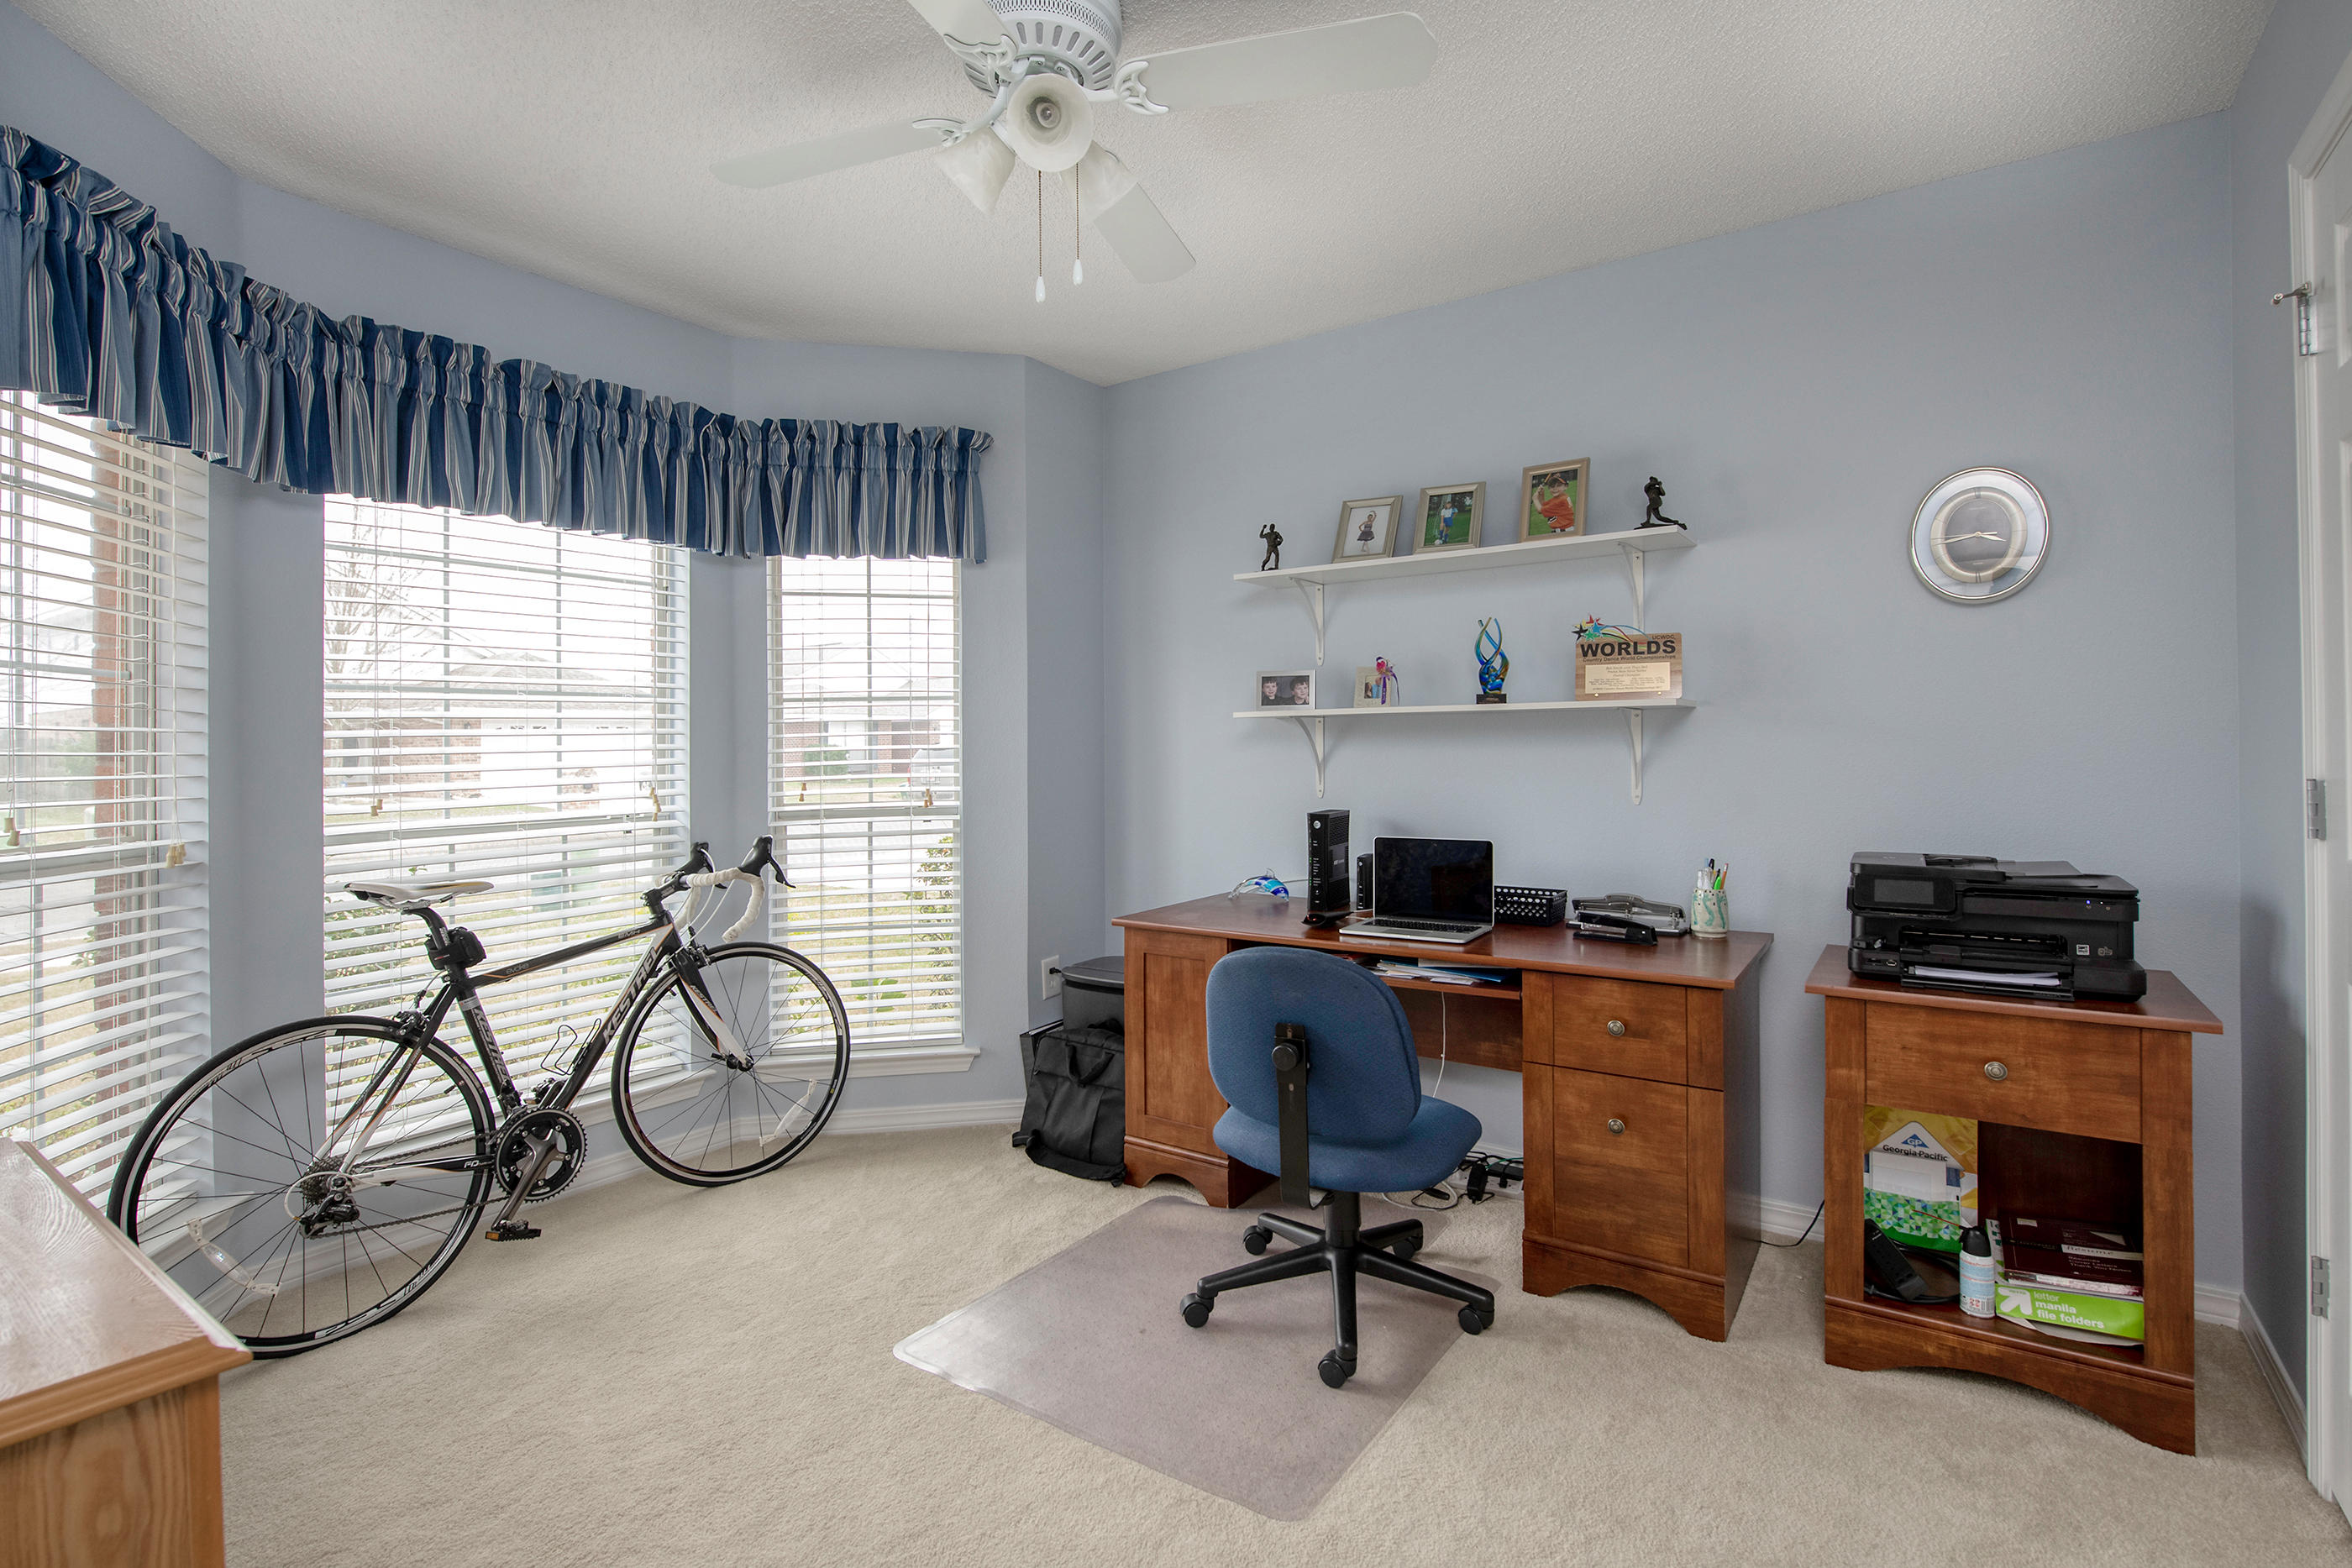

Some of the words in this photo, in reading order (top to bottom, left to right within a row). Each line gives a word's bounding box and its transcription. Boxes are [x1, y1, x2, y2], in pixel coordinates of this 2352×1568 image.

[1580, 640, 1676, 657] WORLDS
[602, 947, 663, 1045] KESTREL
[472, 1007, 511, 1083] KESTRE
[2034, 1291, 2061, 1302] letter
[2035, 1301, 2077, 1314] manila
[2037, 1309, 2057, 1321] file
[2060, 1314, 2105, 1329] folders
